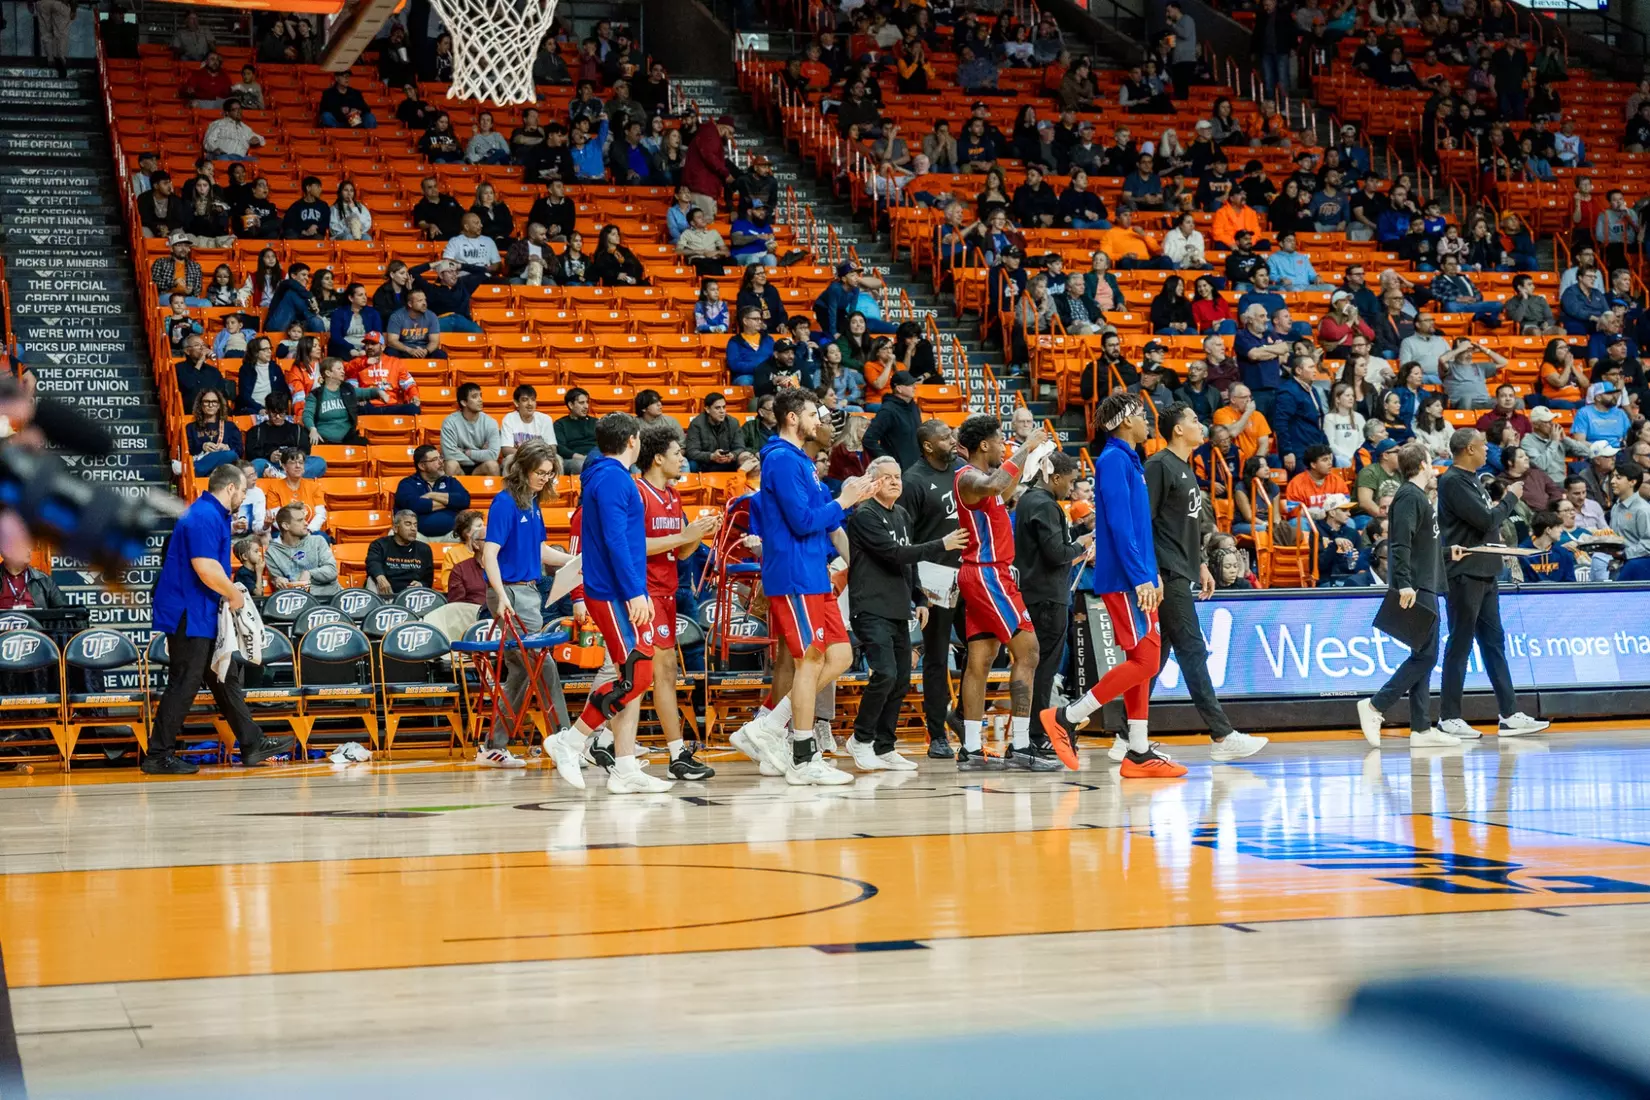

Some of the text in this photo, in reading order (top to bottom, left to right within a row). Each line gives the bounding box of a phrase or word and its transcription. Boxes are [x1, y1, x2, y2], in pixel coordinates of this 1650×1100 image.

[8, 140, 28, 148] THE
[42, 178, 67, 186] WITH
[301, 208, 321, 221] GAP
[47, 235, 88, 246] GECU
[15, 258, 46, 267] PICKS
[66, 258, 108, 267] MINERS!
[28, 280, 107, 290] THE OFFICIAL
[17, 304, 121, 314] OF UTEP ATHLETICS
[28, 329, 120, 338] WE'RE WITH YOU
[25, 343, 58, 351] PICKS
[80, 343, 125, 352] MINERS!
[65, 353, 110, 364] GECU
[37, 369, 122, 378] THE OFFICIAL
[36, 381, 129, 391] CREDIT UNION
[78, 397, 140, 405] ATHLETICS
[321, 398, 346, 414] HANAL
[114, 426, 140, 435] YOU
[112, 439, 148, 448] NERS!
[81, 455, 130, 467] GECU
[82, 470, 144, 481] OFFICIAL
[113, 487, 150, 497] NION
[145, 536, 164, 547] OU
[65, 591, 153, 605] THE OFFICI
[89, 609, 124, 621] EDIT
[316, 626, 353, 652] UTEP
[397, 626, 433, 652] UTEP
[1099, 613, 1117, 671] CHEVRO
[1507, 632, 1542, 657] It's
[1547, 635, 1610, 656] more
[2, 634, 41, 662] UTEP
[82, 632, 120, 659] UTEP
[562, 647, 571, 660] G
[1077, 628, 1086, 696] CHEVROL
